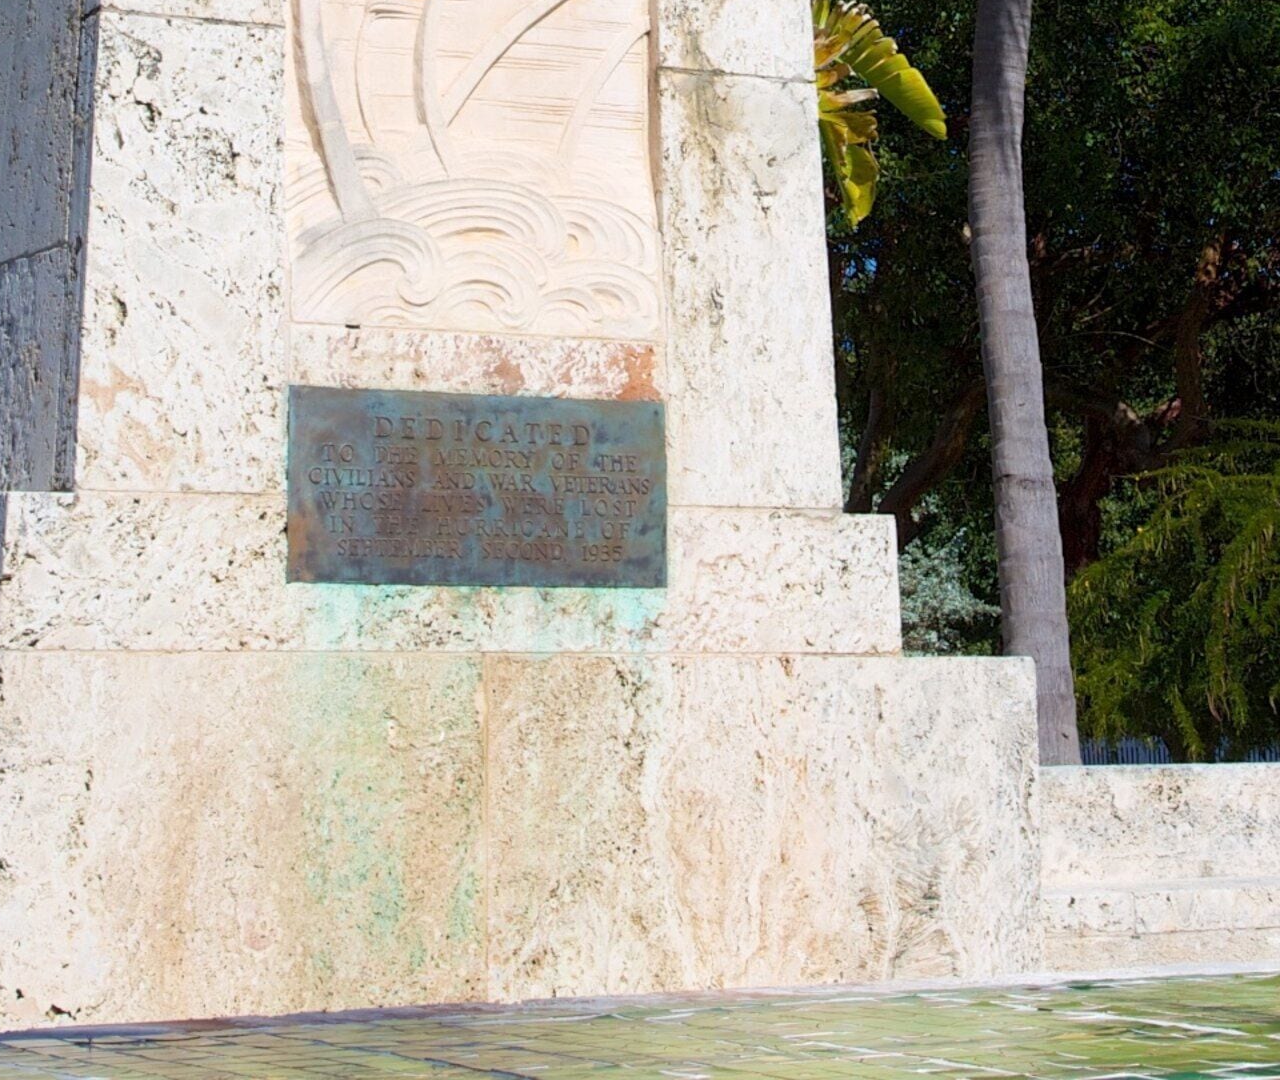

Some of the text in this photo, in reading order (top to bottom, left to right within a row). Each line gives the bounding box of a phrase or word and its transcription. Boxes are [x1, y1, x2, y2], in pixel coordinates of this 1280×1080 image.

[373, 416, 592, 445] DEDICATED
[322, 444, 638, 473] TO THE MEMORY OF THE
[308, 467, 651, 495] CIVILIANS AND WAR VETERANS
[320, 491, 638, 517] WHOSE LIVES WERE LOST
[329, 516, 633, 540] IN THE HURRICANE OF
[337, 539, 463, 559] SEPTEMBER
[582, 543, 624, 563] 1935
